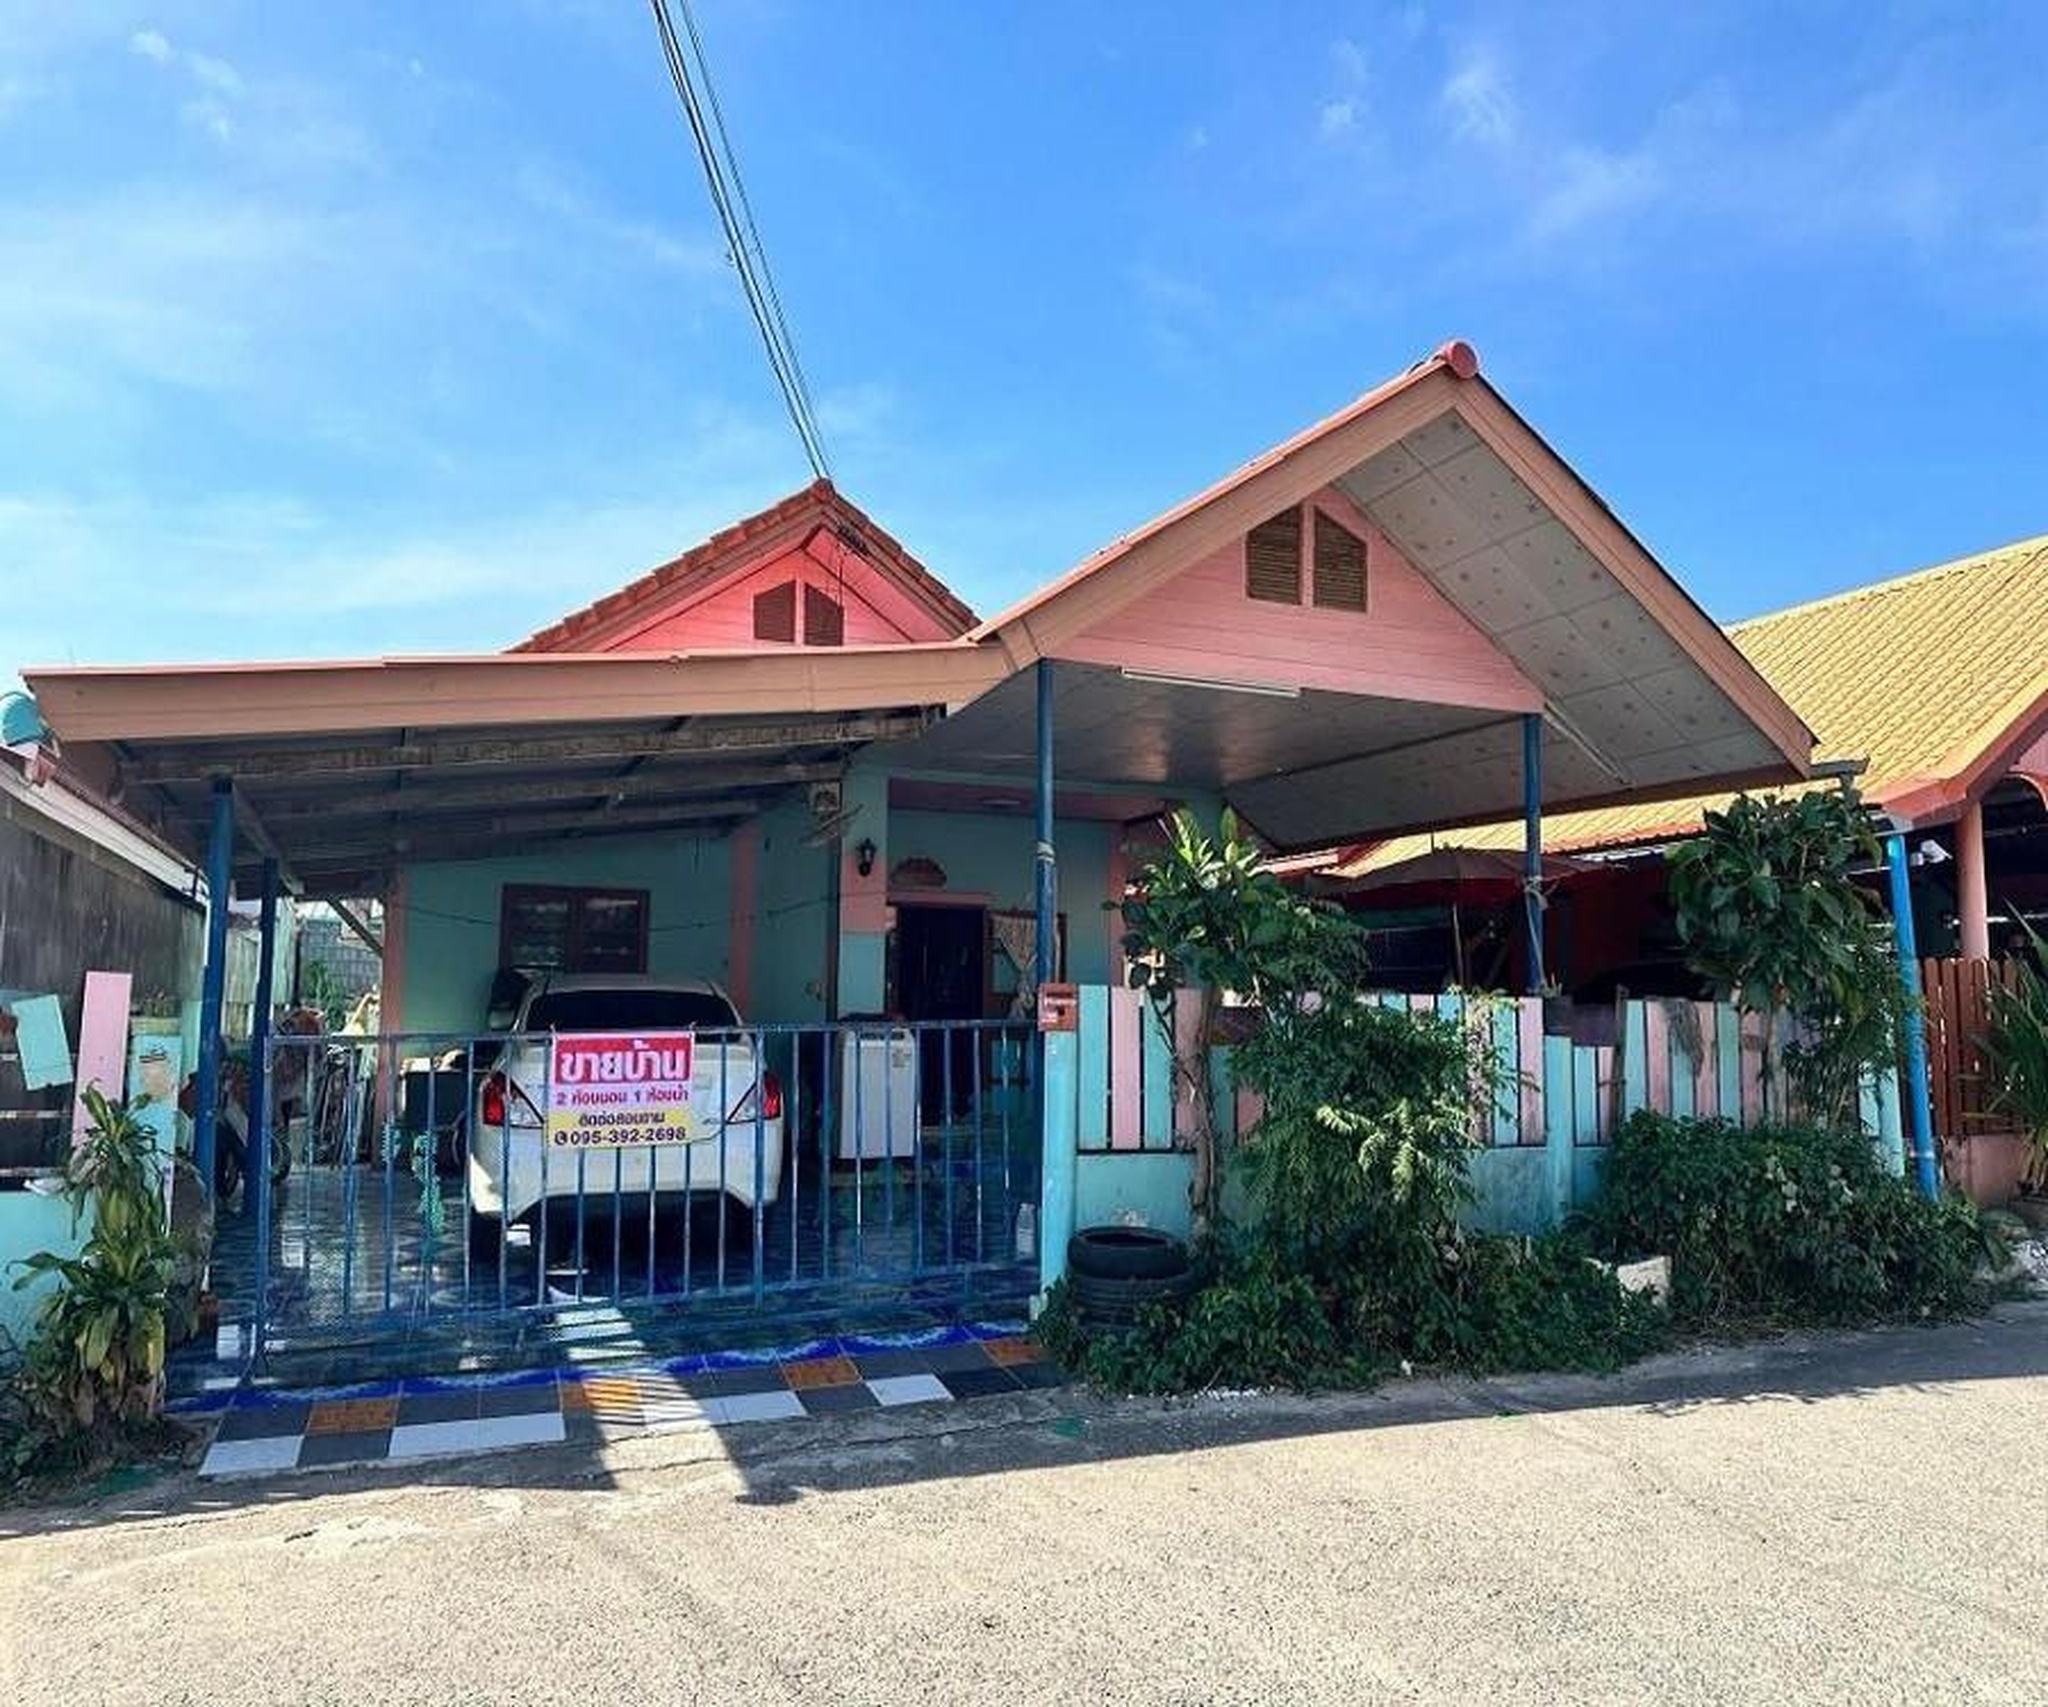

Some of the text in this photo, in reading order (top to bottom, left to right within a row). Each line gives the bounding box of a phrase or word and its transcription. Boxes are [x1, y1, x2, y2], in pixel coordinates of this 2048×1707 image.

[560, 1039, 686, 1082] ขายบ้าน
[556, 1092, 566, 1105] 2
[634, 1090, 641, 1101] 1
[570, 1127, 686, 1145] 095-392-2698
